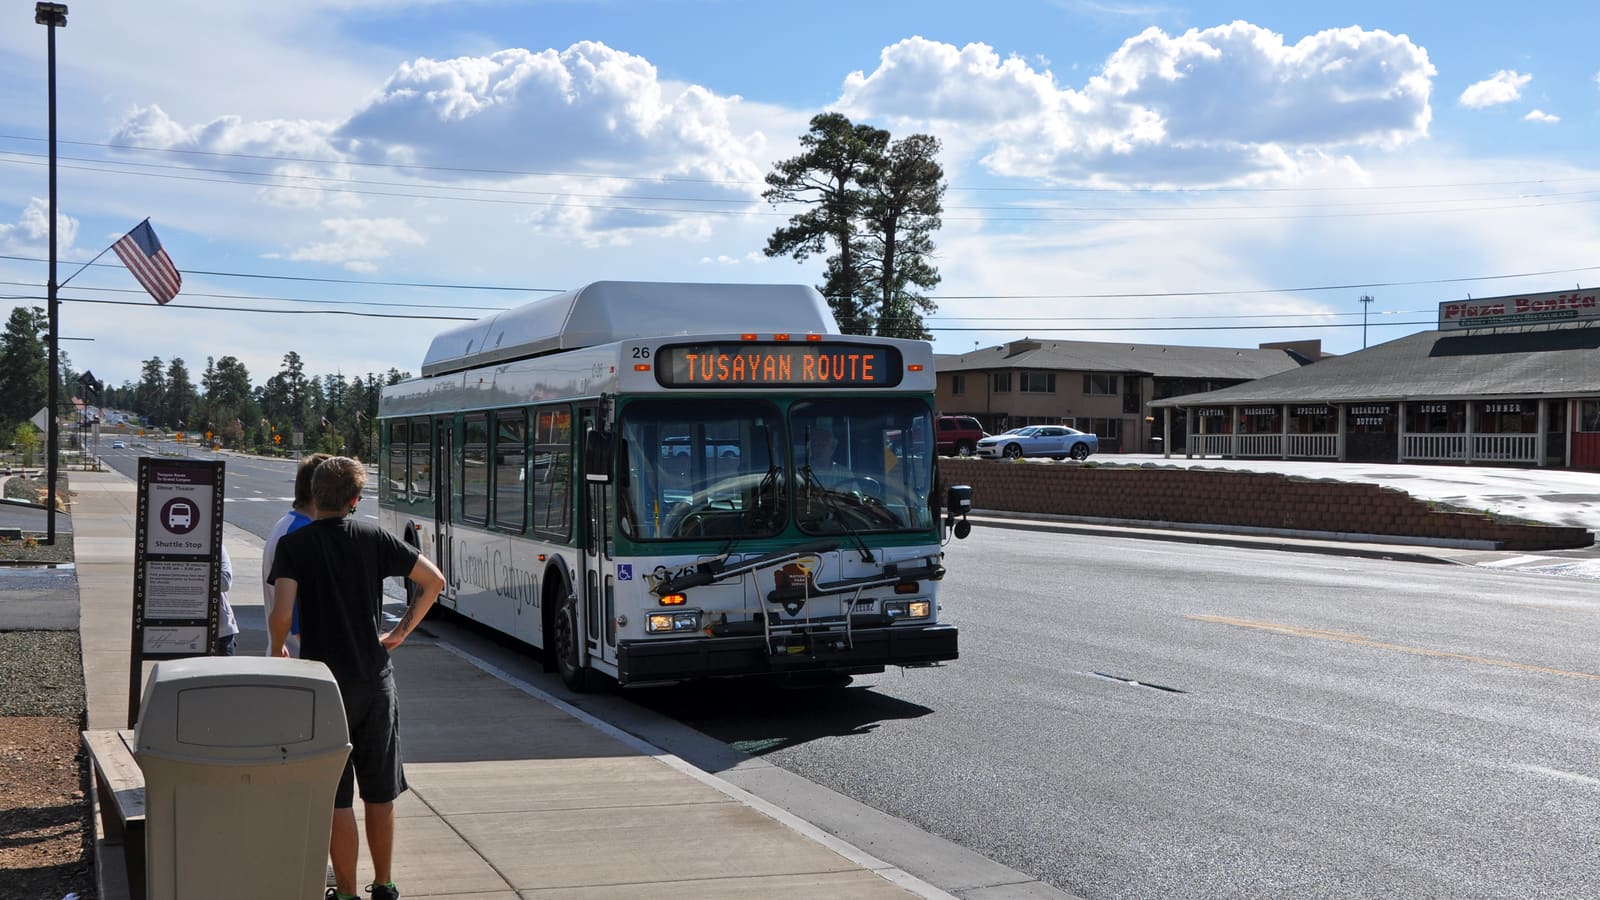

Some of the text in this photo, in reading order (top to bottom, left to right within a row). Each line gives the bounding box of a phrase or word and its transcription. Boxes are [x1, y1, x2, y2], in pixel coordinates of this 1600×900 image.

[1444, 303, 1505, 319] Plaza
[1515, 294, 1596, 313] Bonita
[632, 347, 650, 359] 26
[686, 354, 875, 381] TUSAYAN ROUTE
[1297, 407, 1328, 415] SPECIALS
[1351, 406, 1391, 415] BREAKFAST
[1421, 405, 1447, 413] LUNCH
[1485, 404, 1520, 413] DINNER
[1356, 417, 1383, 425] BUFFET
[155, 540, 202, 550] Shuttle Stop
[460, 540, 540, 616] Grand Canyon
[137, 585, 143, 598] to
